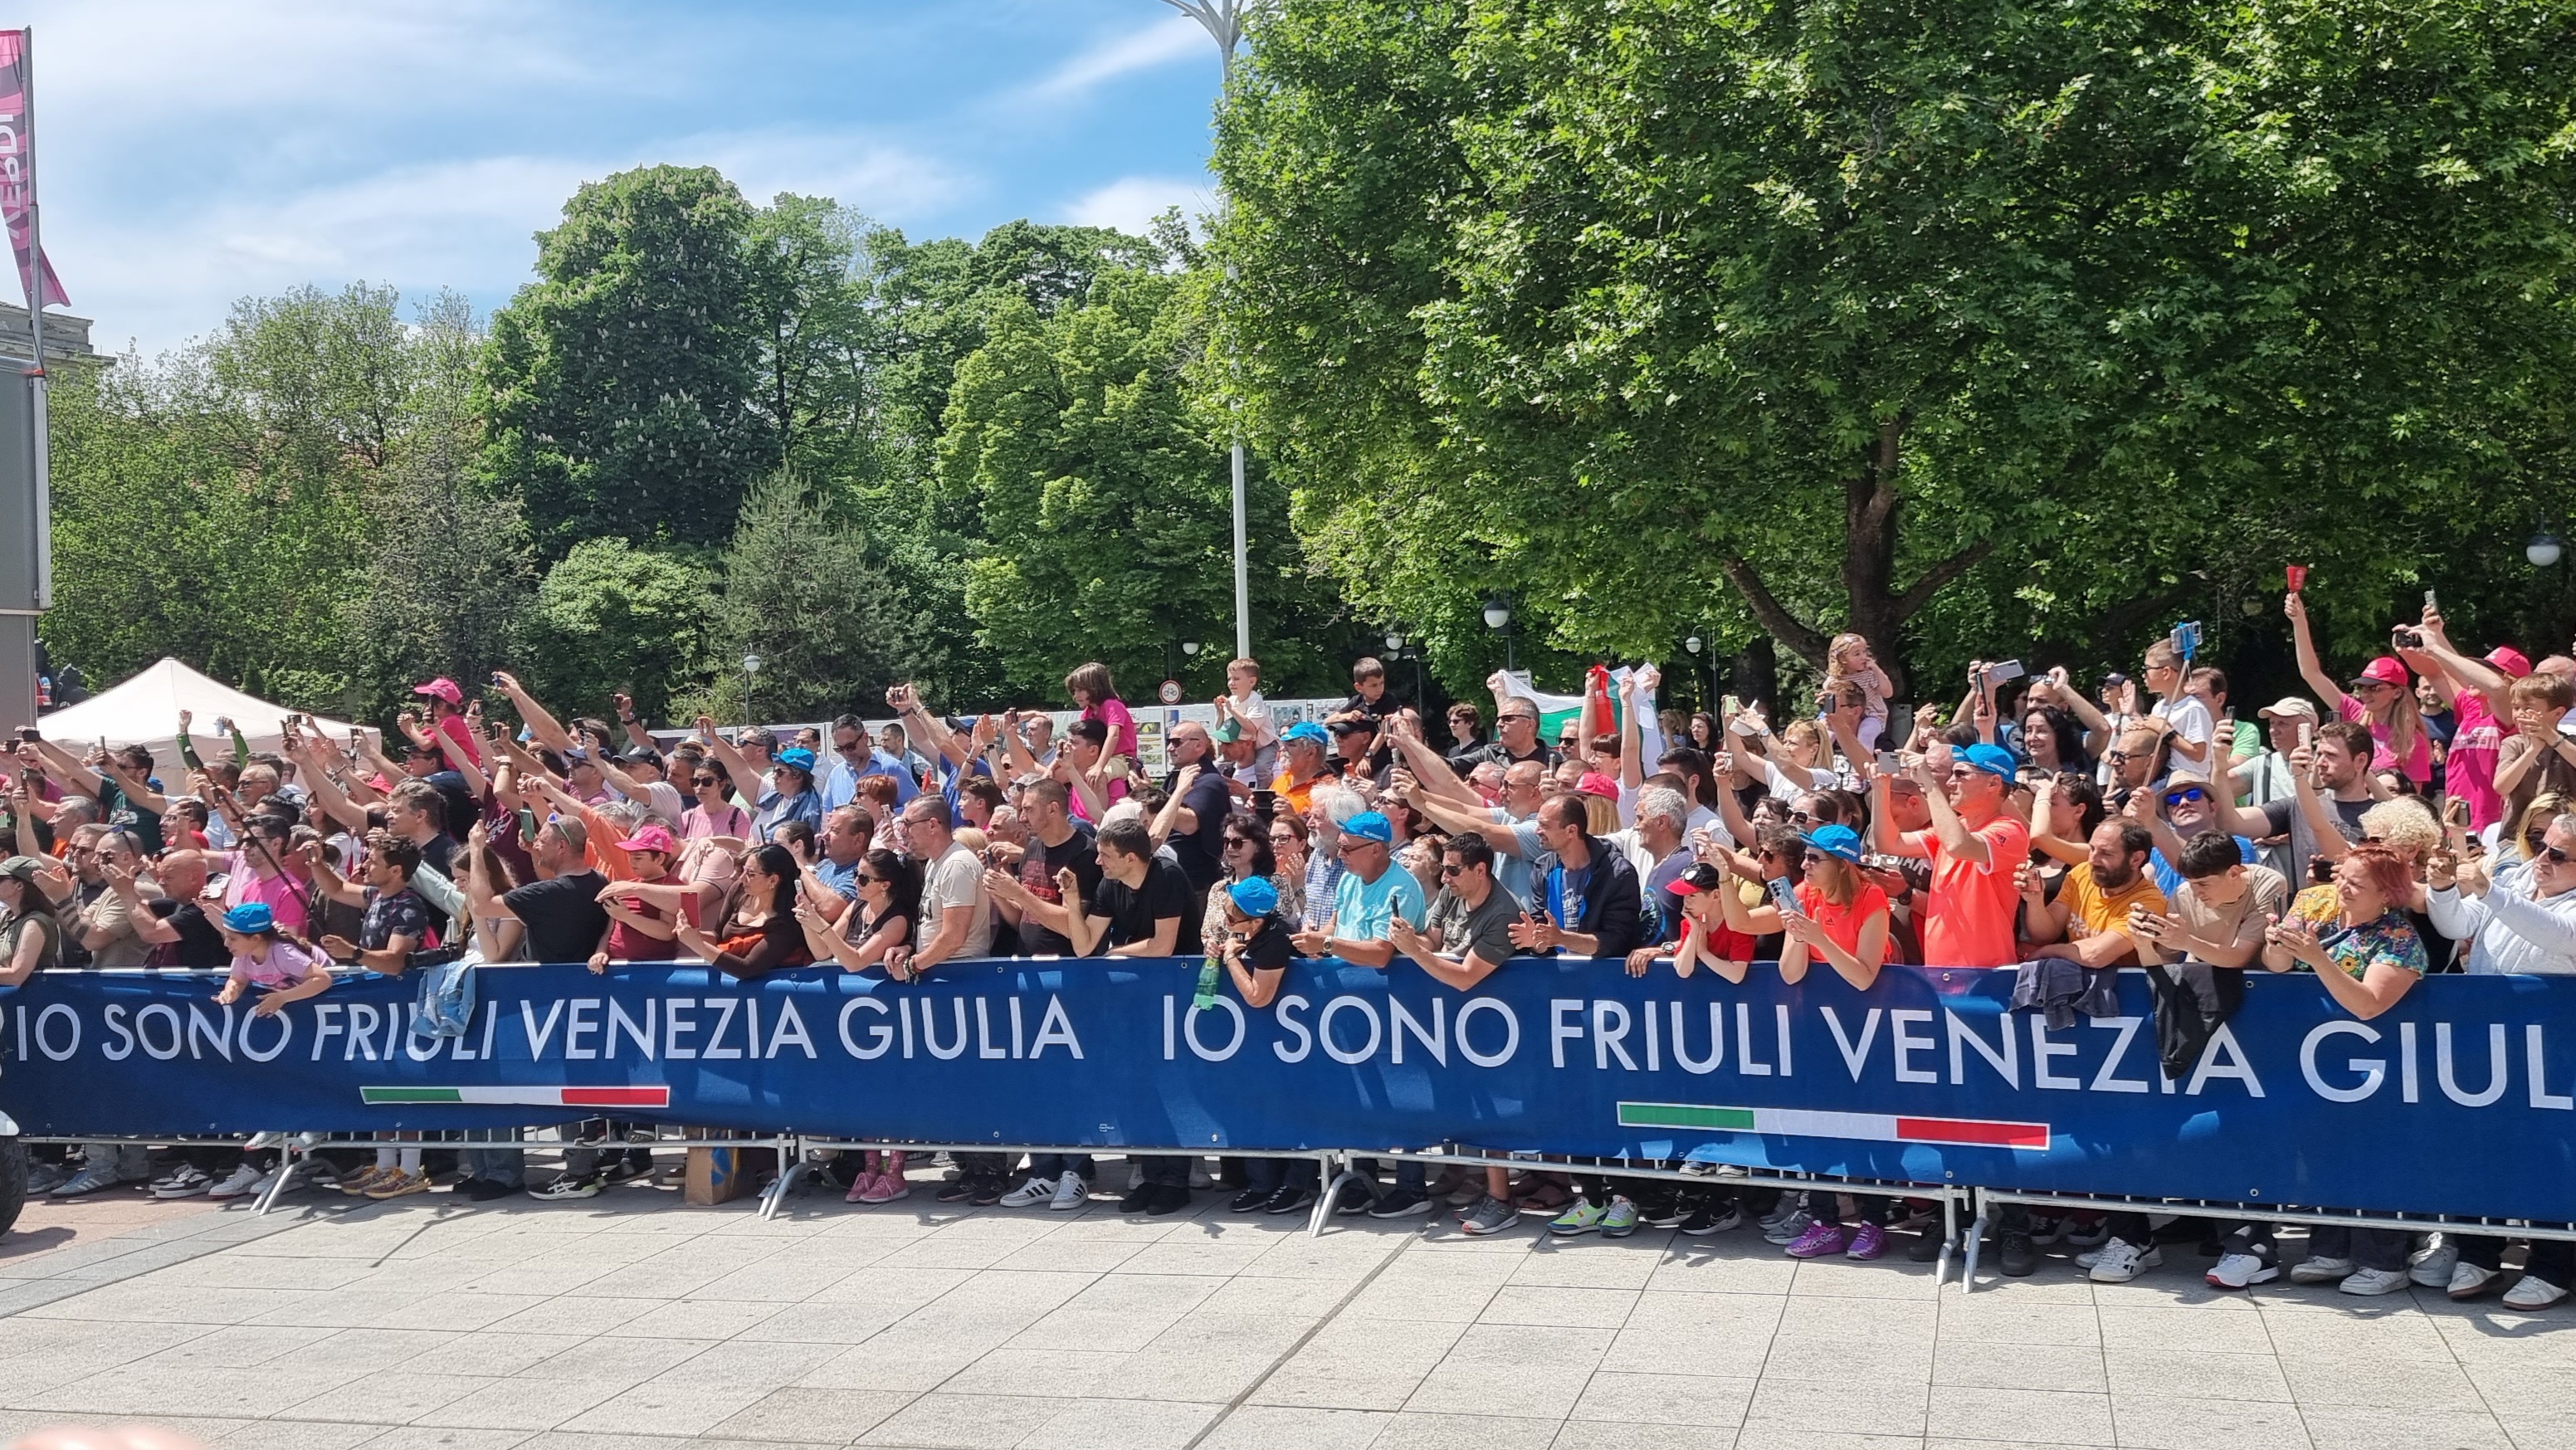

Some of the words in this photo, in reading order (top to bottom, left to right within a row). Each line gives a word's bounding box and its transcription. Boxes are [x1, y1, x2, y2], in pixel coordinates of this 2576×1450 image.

[17, 1003, 81, 1062] IO
[102, 1003, 293, 1063] SONO
[520, 995, 817, 1063] VENEZIA
[838, 993, 1085, 1060] GIULIA
[1164, 993, 1245, 1062] IO
[1273, 994, 1520, 1068] SONO
[1550, 998, 1793, 1077] FRIULI
[2300, 1020, 2574, 1111] GIUL
